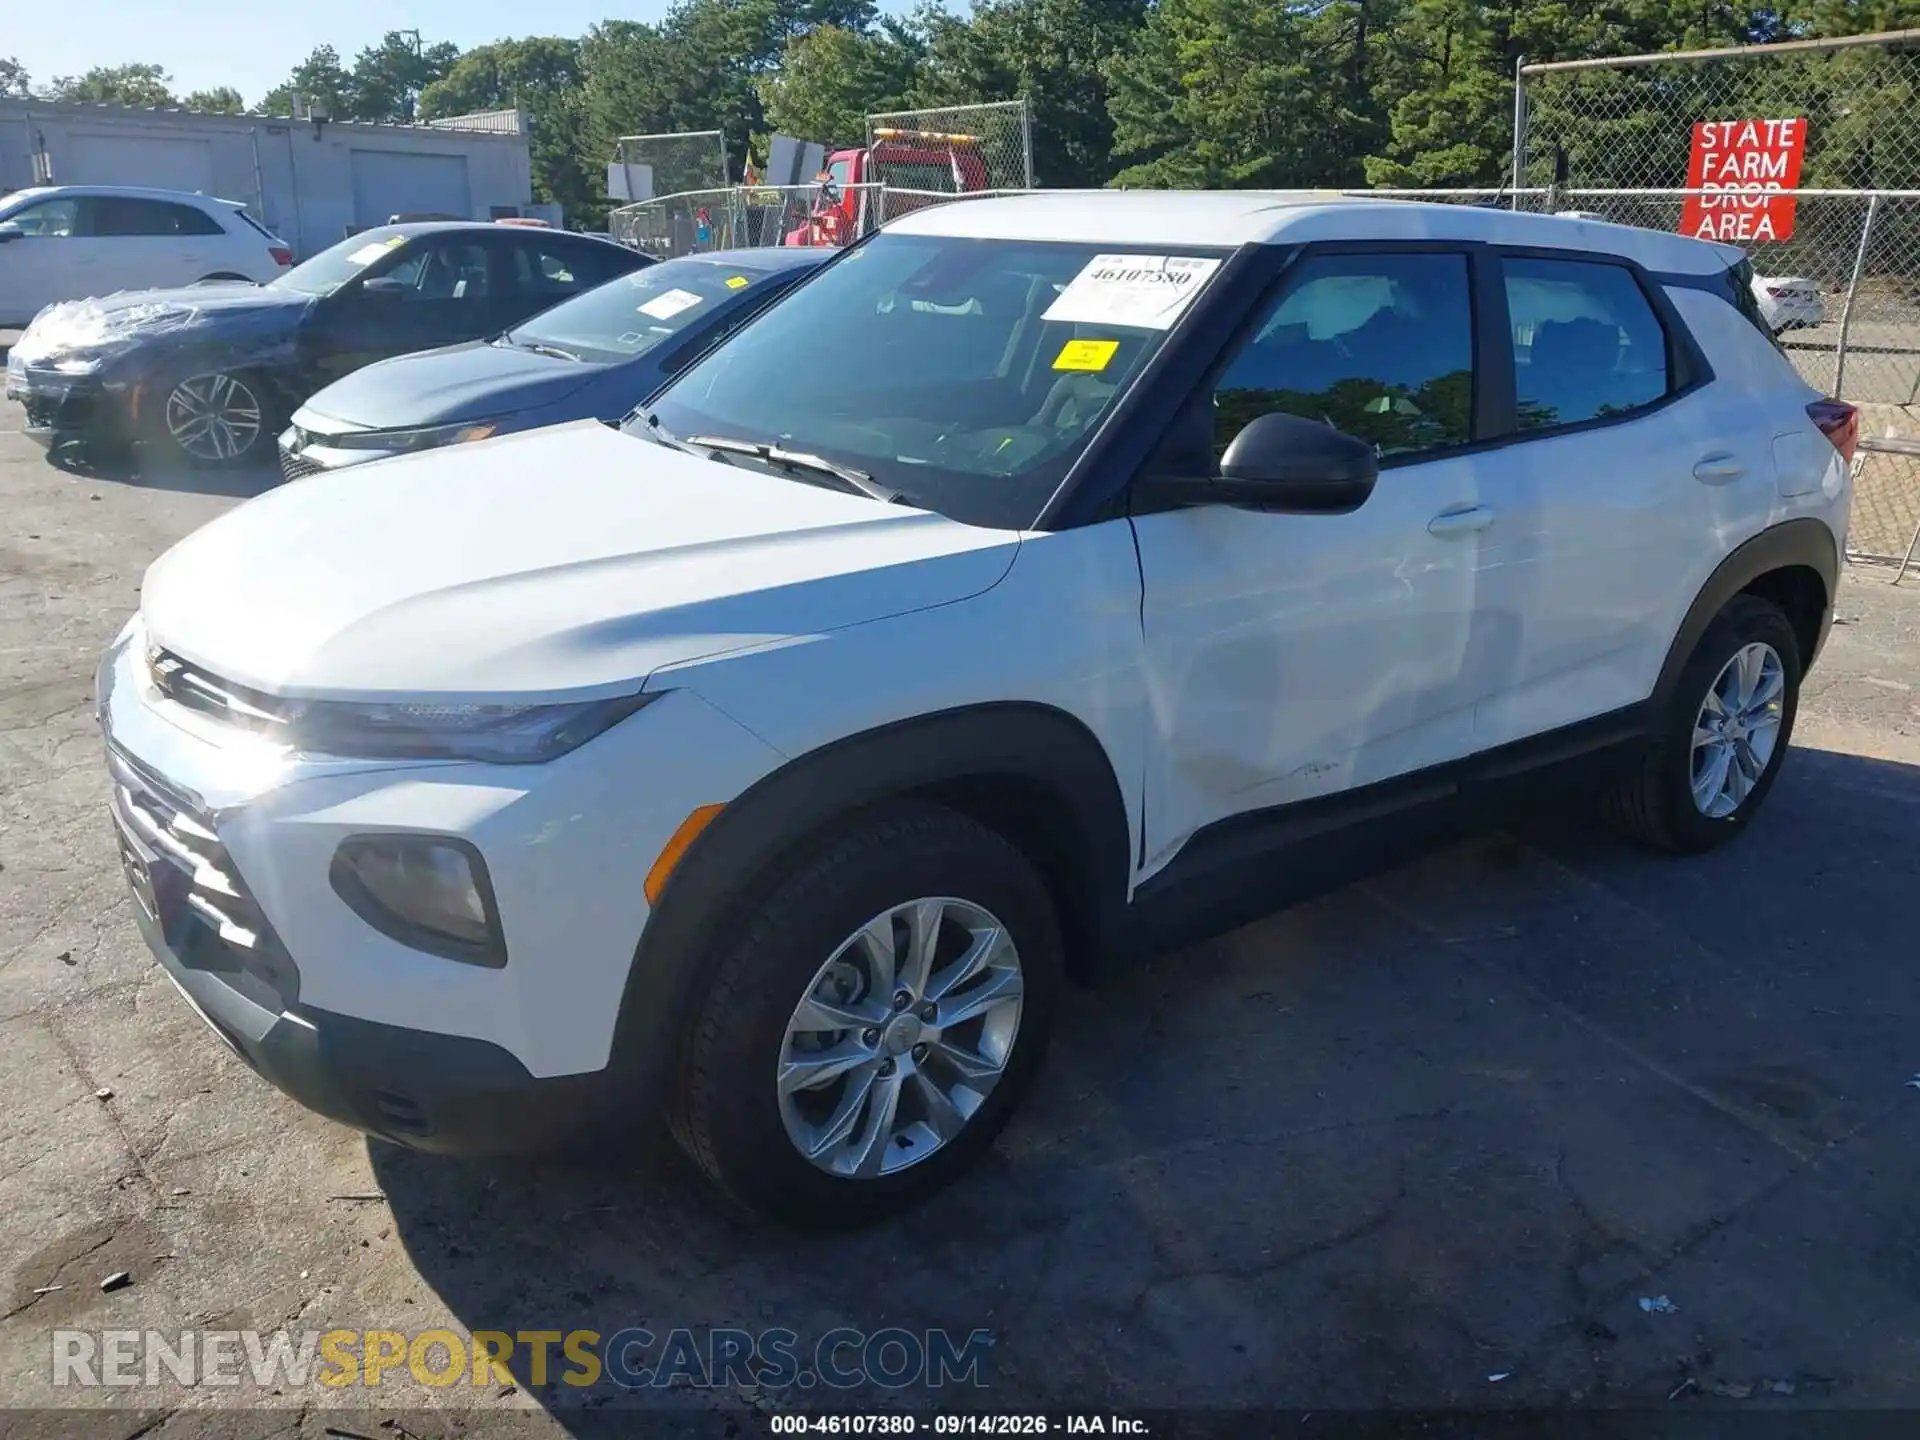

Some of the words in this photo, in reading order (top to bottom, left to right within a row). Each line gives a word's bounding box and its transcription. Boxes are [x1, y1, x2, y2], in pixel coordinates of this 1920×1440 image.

[1701, 118, 1797, 149] STATE
[1702, 151, 1788, 179] FARM
[1700, 182, 1782, 208] DROP
[1694, 213, 1776, 240] AREA
